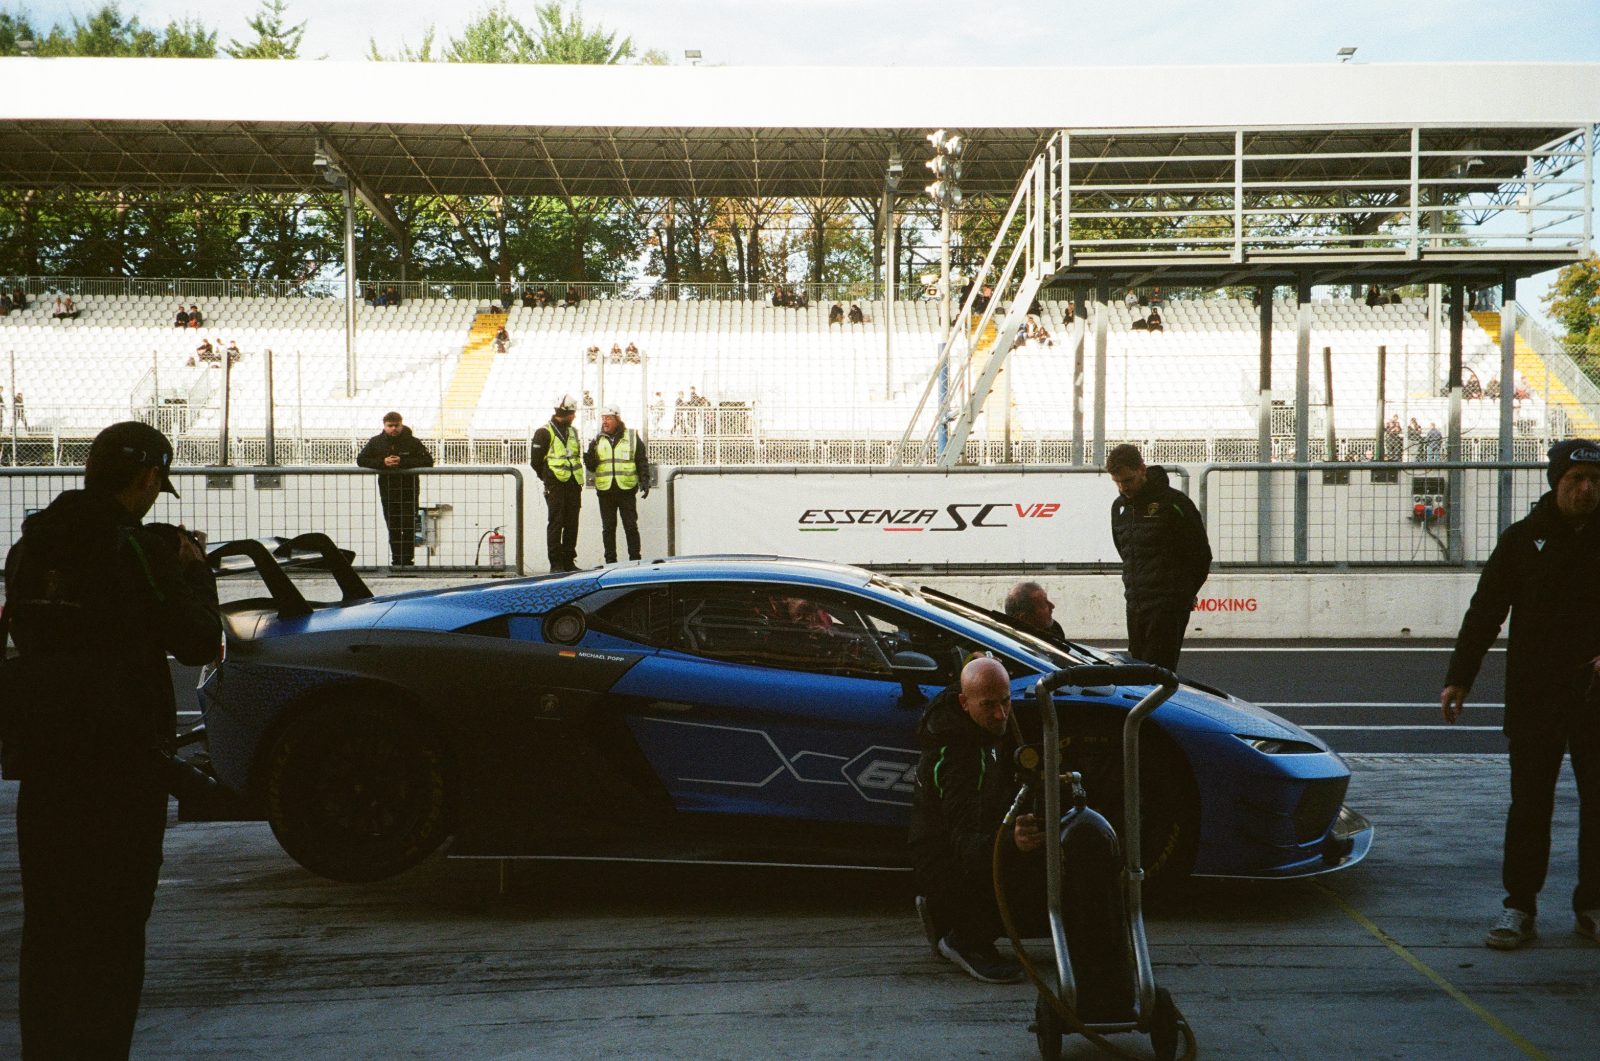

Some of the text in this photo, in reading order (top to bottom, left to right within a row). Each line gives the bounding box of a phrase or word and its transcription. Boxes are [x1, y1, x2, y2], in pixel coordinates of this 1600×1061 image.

[798, 509, 938, 524] ESSENZA
[1193, 598, 1257, 612] MOKING
[578, 652, 605, 660] MICHAEL
